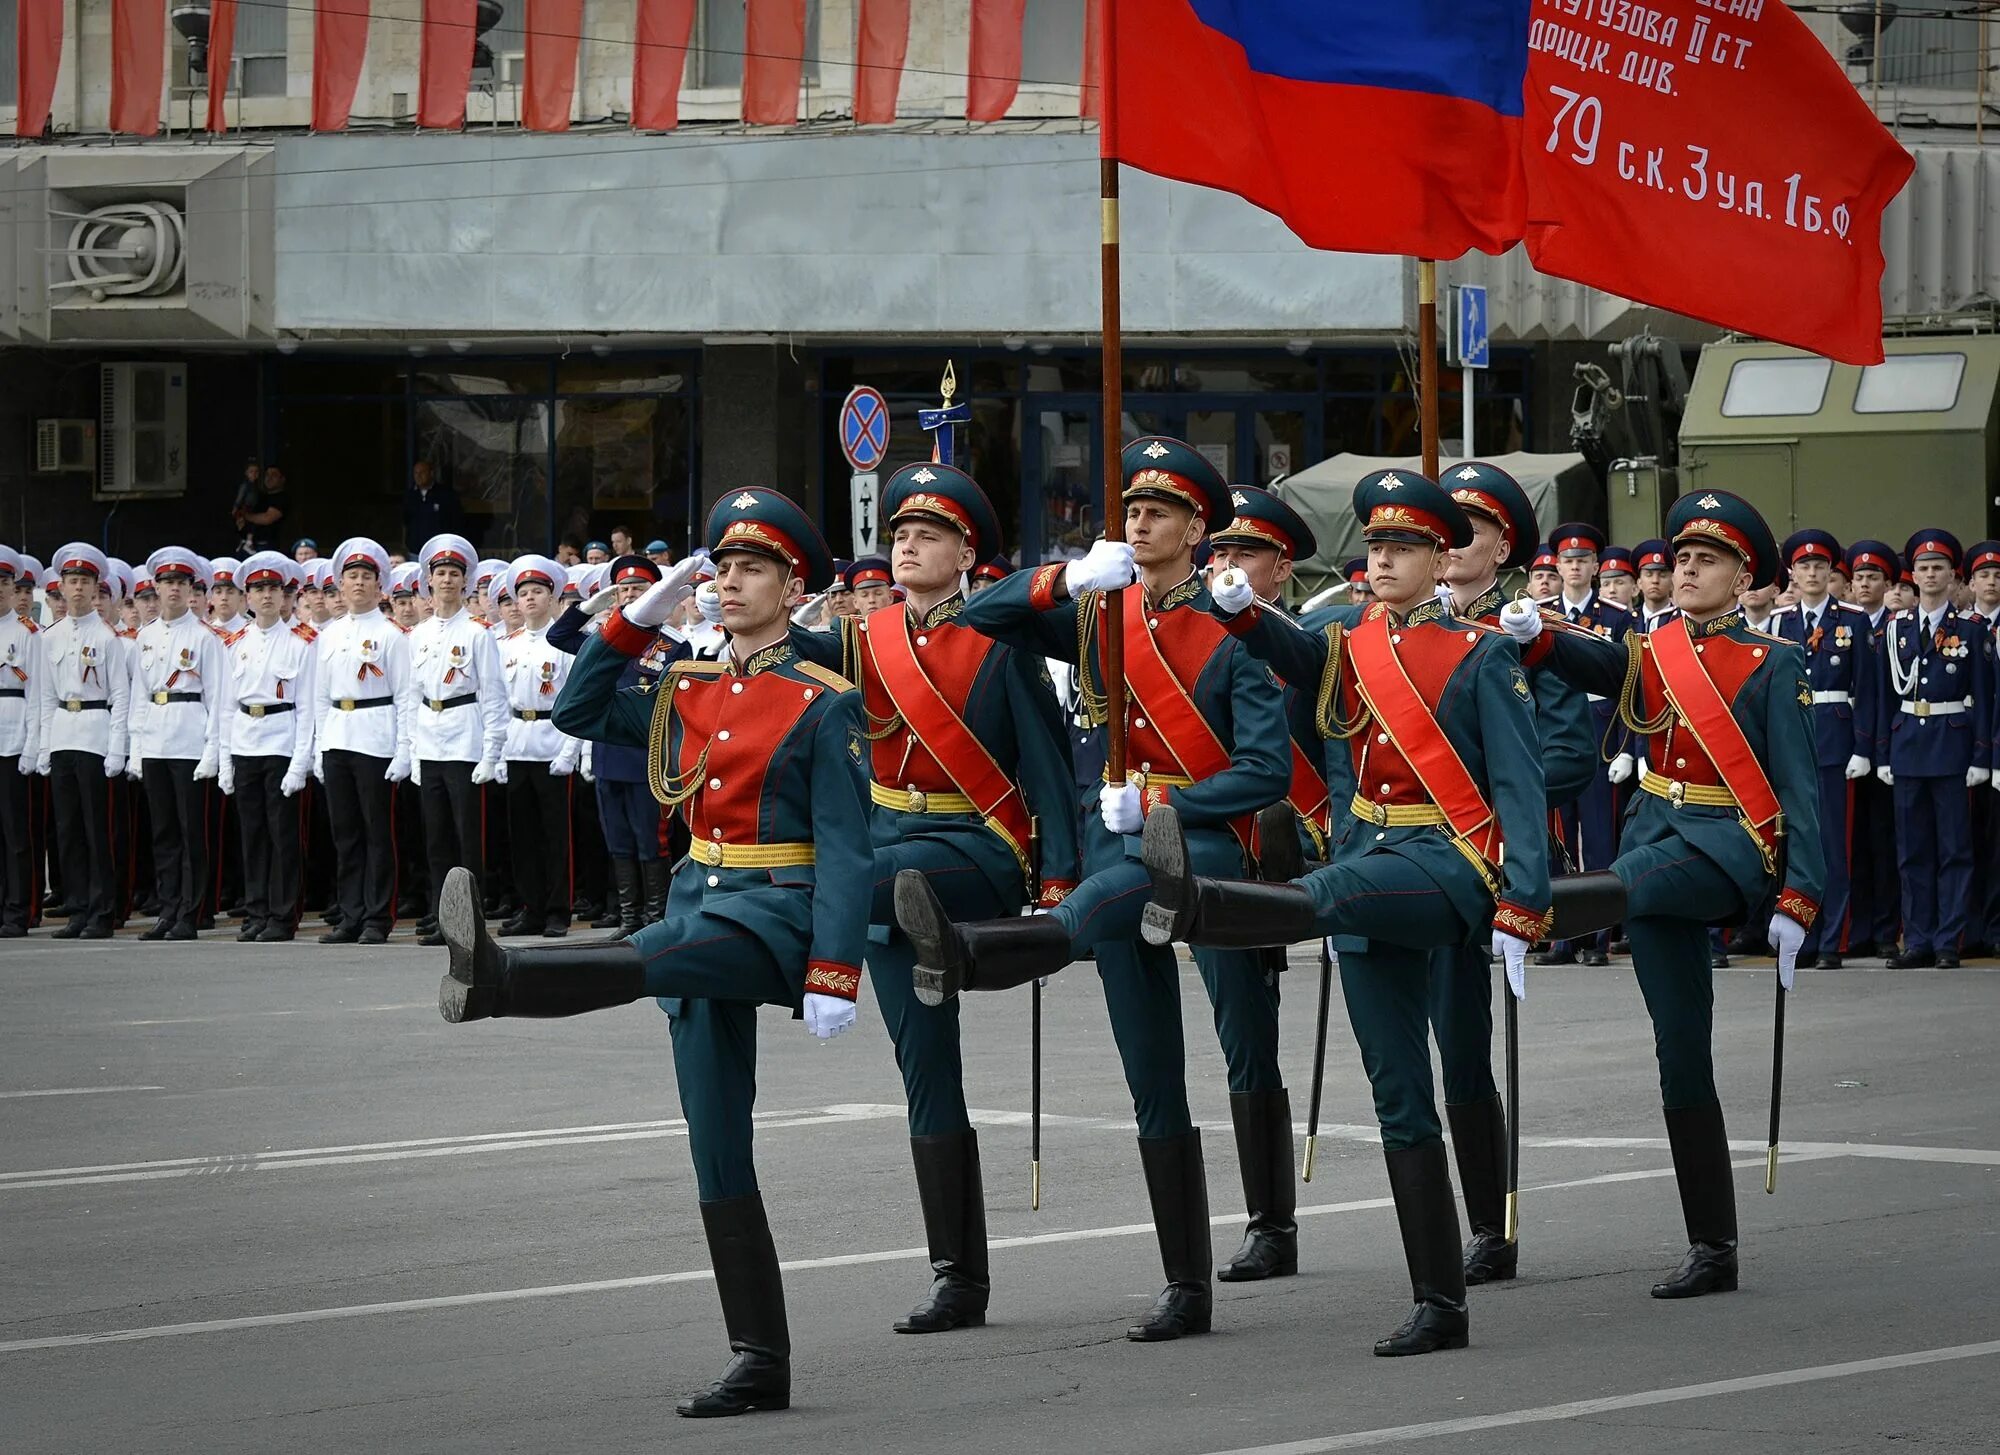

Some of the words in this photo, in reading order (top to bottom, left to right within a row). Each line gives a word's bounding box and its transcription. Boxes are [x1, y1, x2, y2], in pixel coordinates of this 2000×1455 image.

[1543, 0, 1679, 48] УТУЗОВА
[1618, 50, 1679, 97] ДИВ.
[1545, 85, 1602, 166] 79
